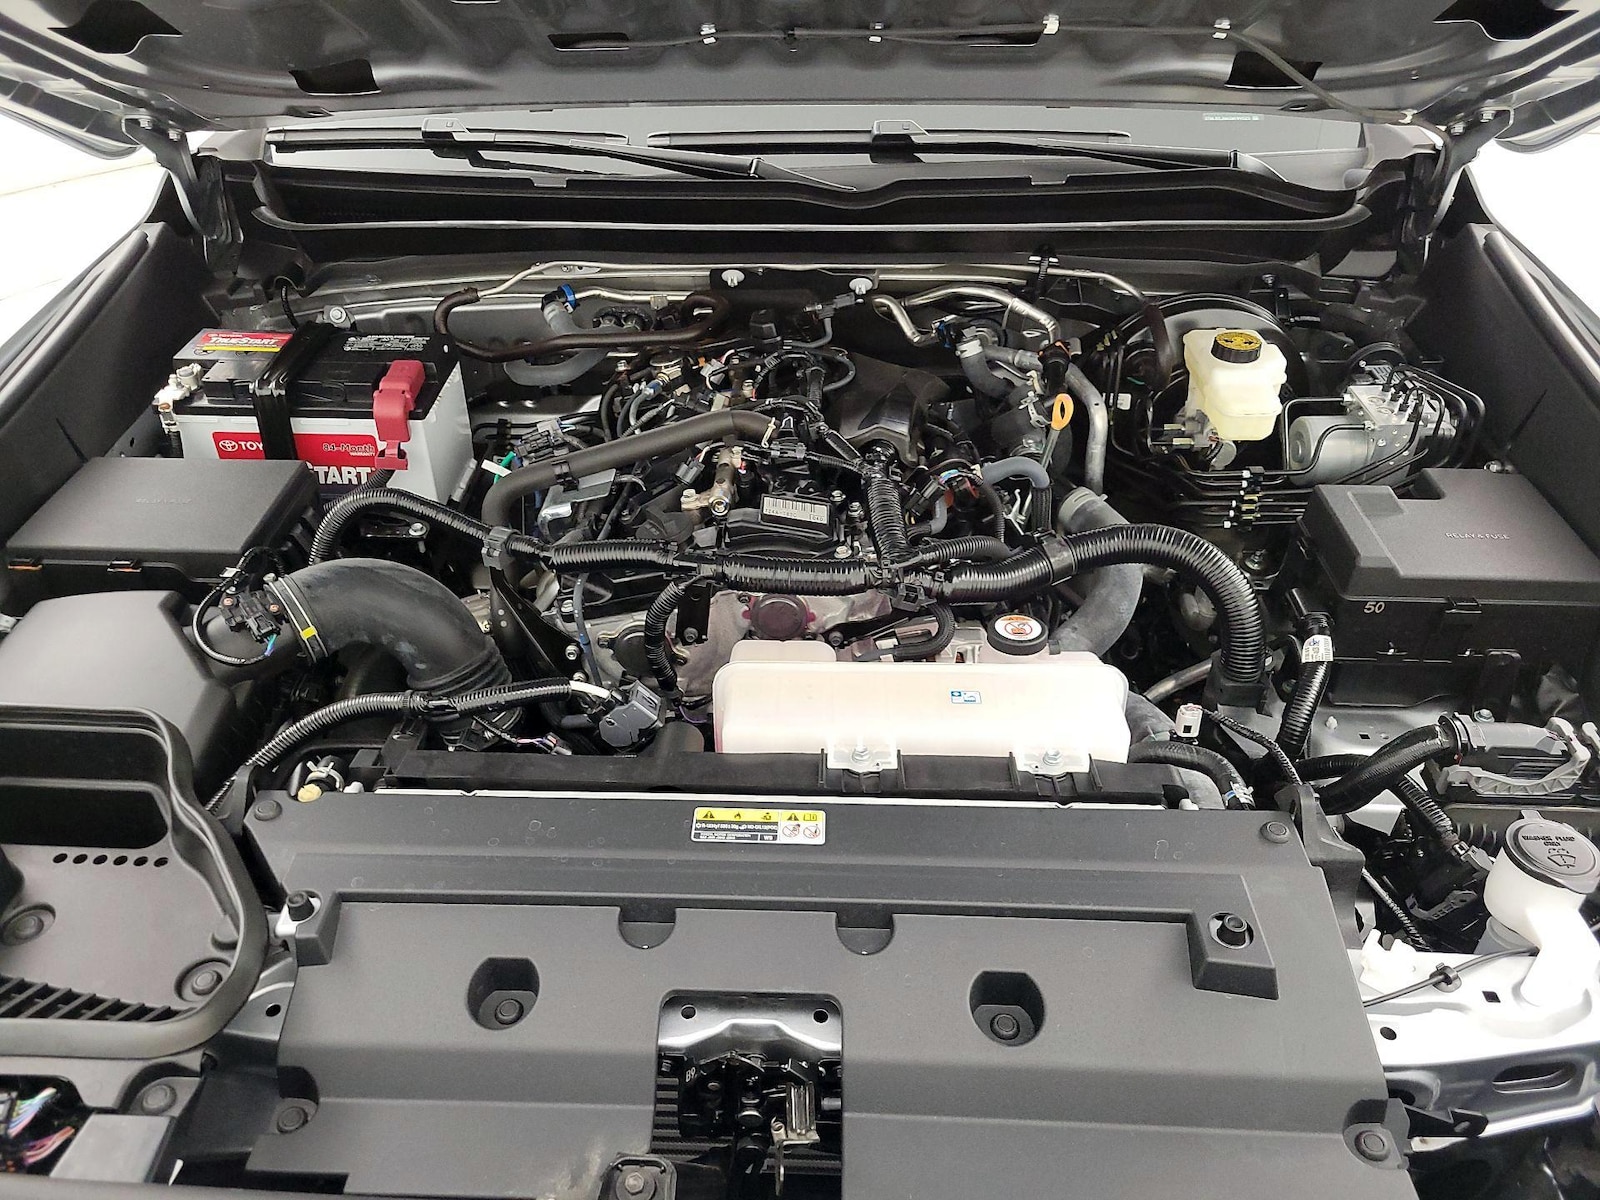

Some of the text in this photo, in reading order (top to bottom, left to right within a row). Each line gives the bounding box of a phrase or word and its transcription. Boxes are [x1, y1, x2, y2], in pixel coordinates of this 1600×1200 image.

[238, 441, 264, 450] TOY
[322, 442, 375, 453] 84-Month
[1363, 601, 1386, 614] 50
